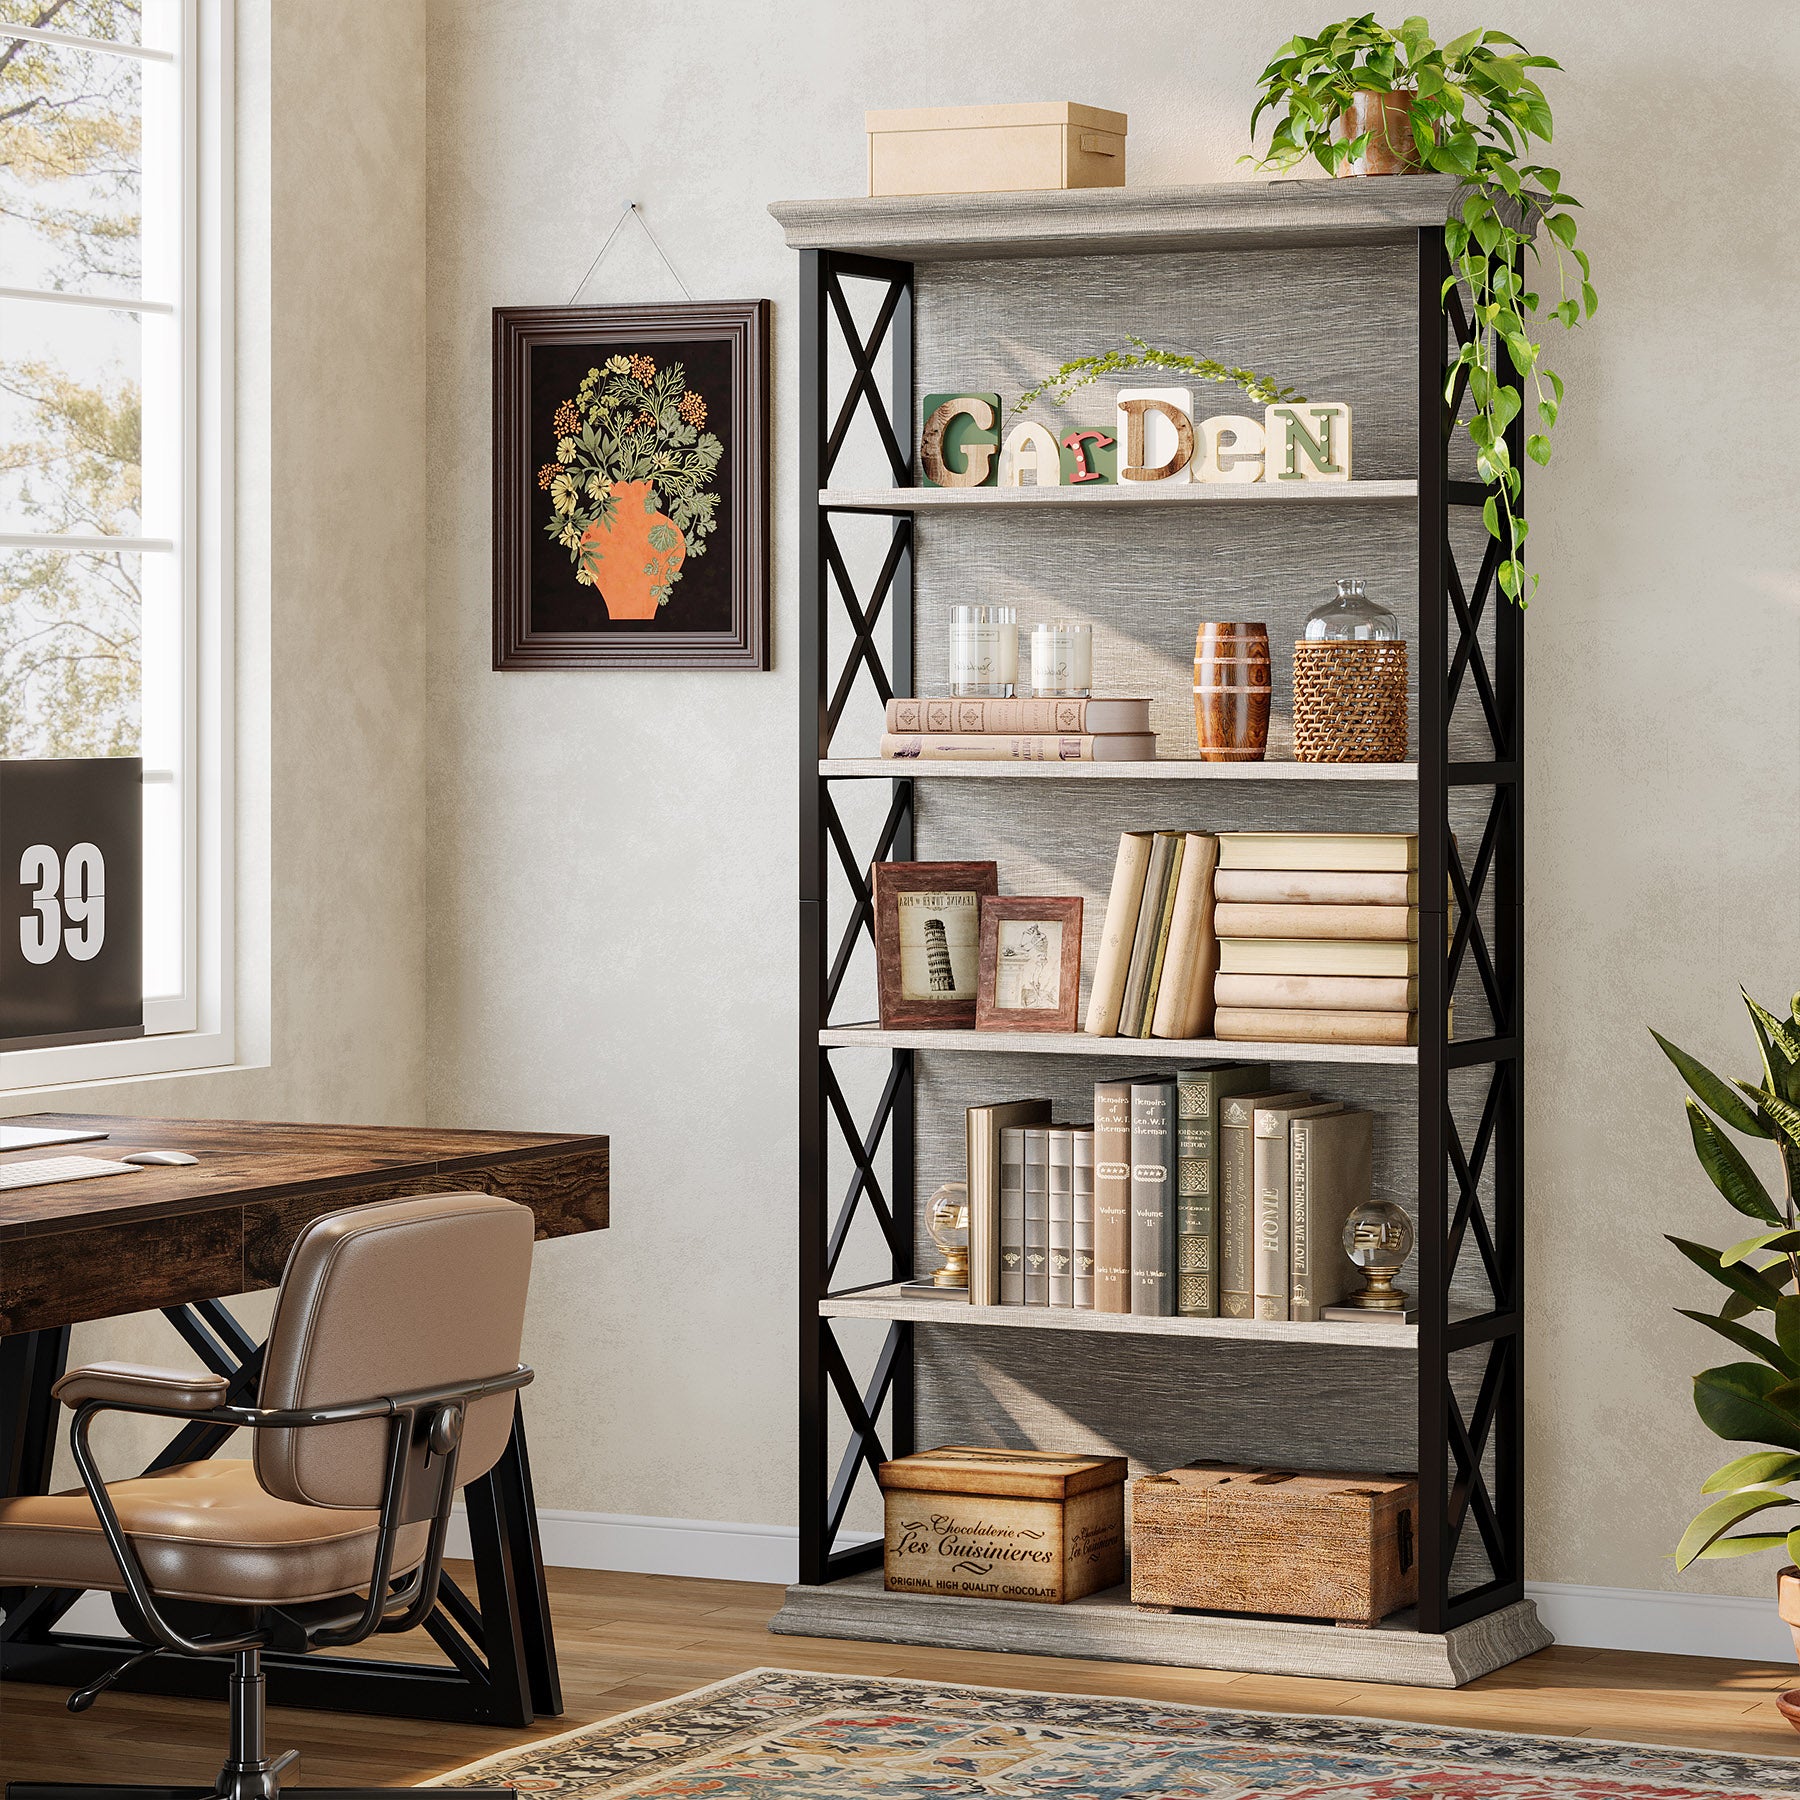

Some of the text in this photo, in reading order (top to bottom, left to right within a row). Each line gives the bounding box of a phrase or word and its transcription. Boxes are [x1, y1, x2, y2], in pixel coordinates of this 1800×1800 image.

[19, 842, 106, 965] 39
[1097, 1095, 1129, 1104] Memoirs
[1134, 1098, 1166, 1106] Memoirs
[1109, 1105, 1118, 1113] of
[1146, 1107, 1155, 1116] of
[1096, 1124, 1130, 1133] Sherman
[1133, 1126, 1168, 1136] Sherman
[1294, 1132, 1305, 1269] WITH THE THINGS WE LOVE
[1099, 1206, 1127, 1215] Volume
[1136, 1209, 1164, 1218] Volume
[1224, 1208, 1232, 1235] Most
[1261, 1187, 1279, 1253] HOME
[1224, 1240, 1232, 1258] The
[930, 1513, 1016, 1539] Chocolaterie
[890, 1531, 1054, 1564] Les Cuisinieres
[889, 1576, 1057, 1598] ORIGINAL HIGH QUALITY CHOCOLATE
